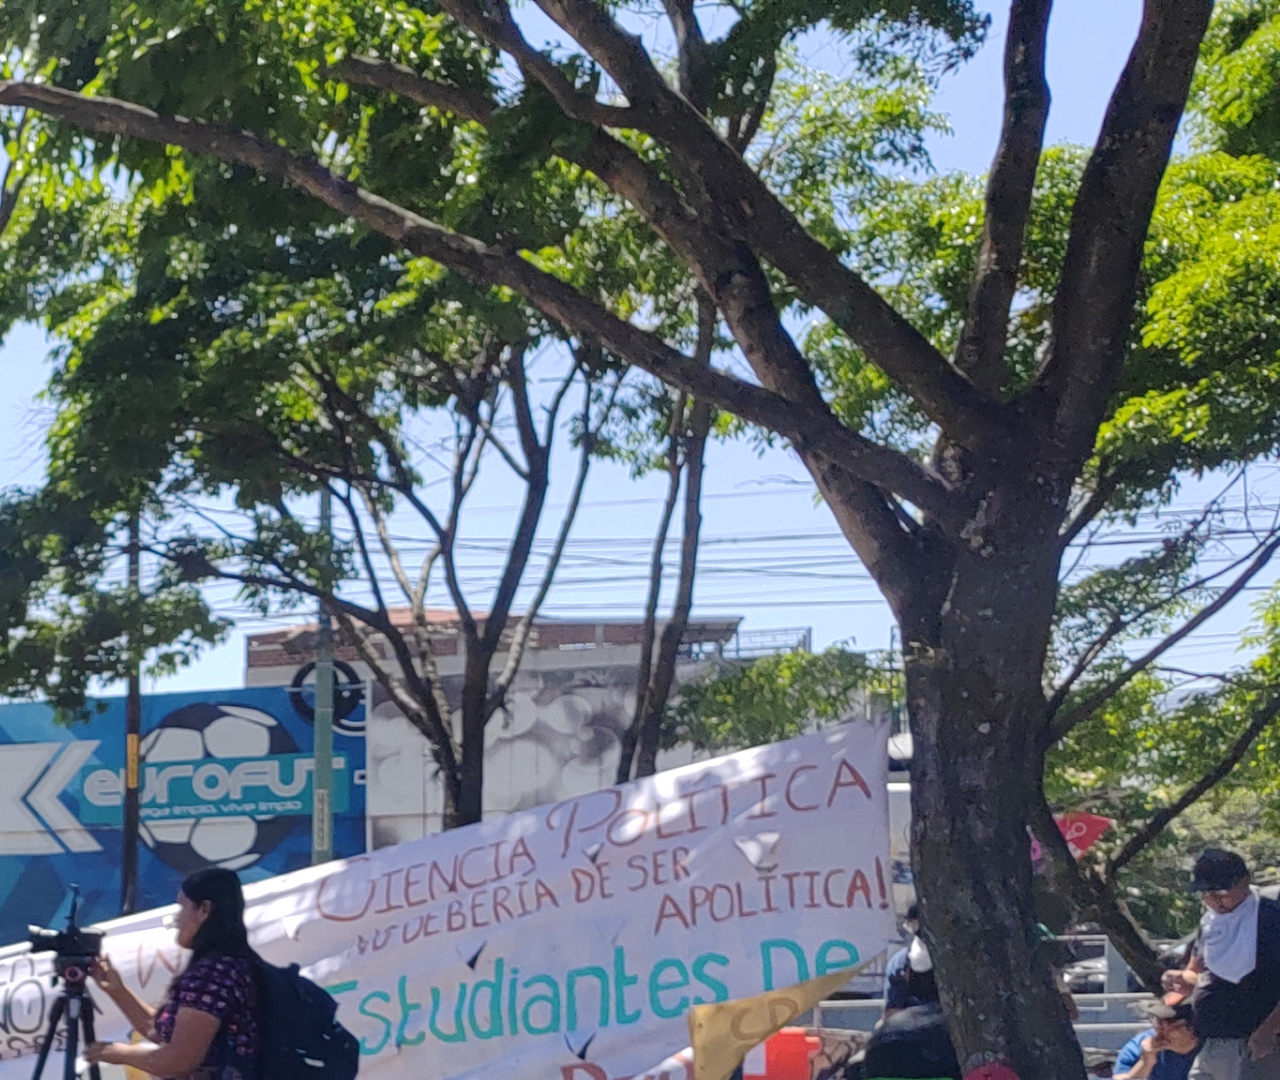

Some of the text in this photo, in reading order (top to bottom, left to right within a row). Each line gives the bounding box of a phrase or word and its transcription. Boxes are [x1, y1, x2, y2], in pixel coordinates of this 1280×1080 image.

[317, 835, 538, 922] CIENCIA
[571, 860, 615, 904] DE
[626, 845, 692, 892] SER
